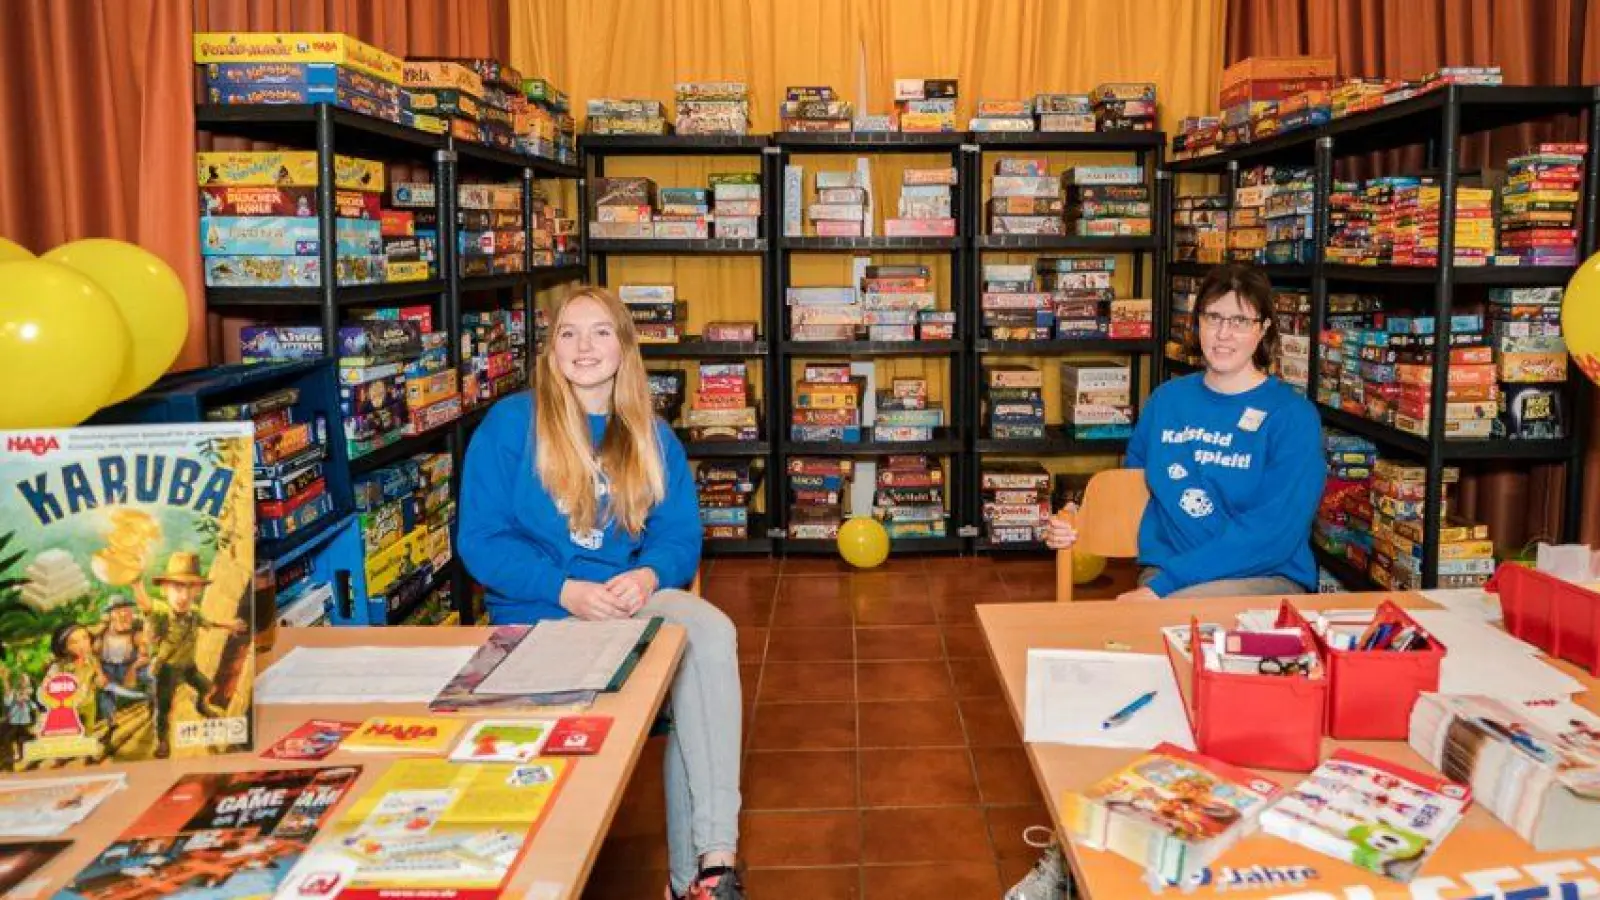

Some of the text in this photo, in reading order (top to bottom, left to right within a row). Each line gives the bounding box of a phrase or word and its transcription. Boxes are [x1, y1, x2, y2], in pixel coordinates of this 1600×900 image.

[7, 436, 60, 456] HABA
[17, 454, 234, 525] KARUBA
[363, 723, 437, 740] HABA
